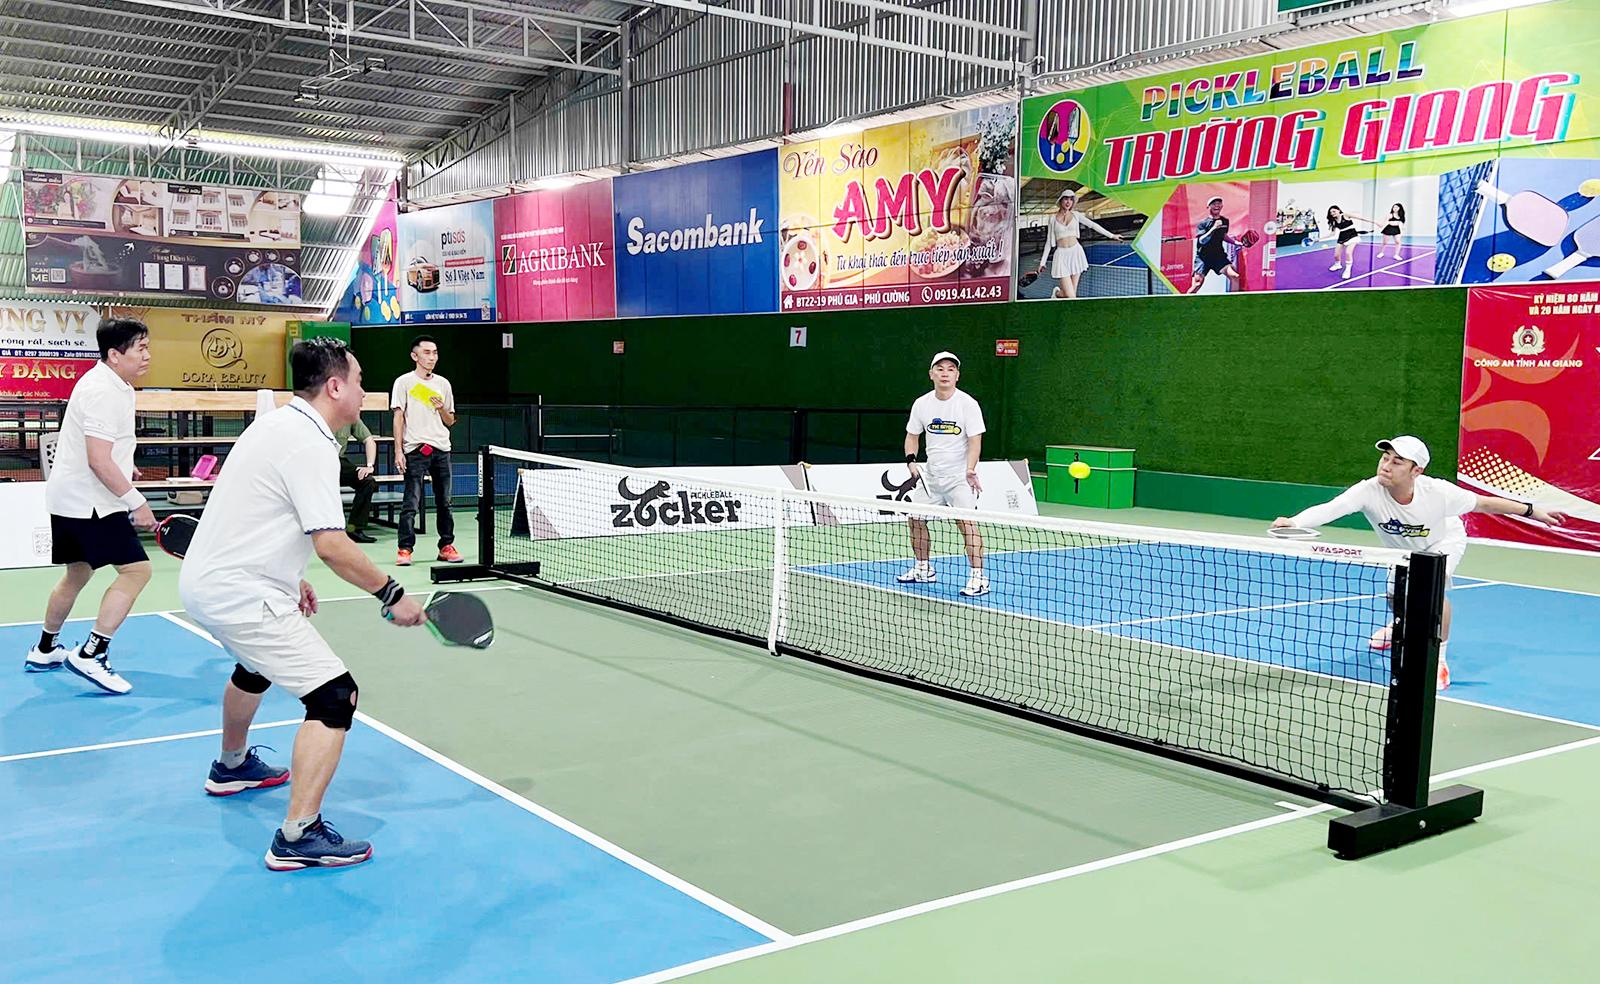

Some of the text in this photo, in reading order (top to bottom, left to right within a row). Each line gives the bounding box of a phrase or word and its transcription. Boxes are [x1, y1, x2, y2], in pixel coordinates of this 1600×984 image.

[1140, 40, 1425, 122] PICKLEBALL
[1103, 72, 1580, 187] TRƯỜNG GIANG
[783, 144, 878, 178] Yến Sào
[832, 166, 966, 244] AMY
[626, 207, 764, 256] Sacombank
[518, 242, 606, 274] AGRIBANK
[890, 247, 908, 266] đến
[31, 275, 49, 283] ME
[796, 296, 827, 308] BT22-19
[828, 292, 843, 306] PHÚ
[845, 294, 858, 305] GIA
[864, 291, 880, 304] PHÚ
[934, 286, 1002, 301] 0919.41.42.43
[1567, 293, 1579, 303] 80
[1541, 305, 1552, 315] 20
[54, 308, 90, 334] VY
[795, 330, 802, 344] 7
[12, 359, 77, 382] ĐẶNG
[1474, 358, 1500, 367] CÔNG
[1501, 359, 1514, 367] AN
[1537, 359, 1551, 367] AN
[1552, 359, 1583, 368] GIANG
[182, 372, 267, 384] DORA BEAUTY
[690, 491, 733, 499] PICKLEBALL
[610, 490, 742, 527] zocker
[1311, 546, 1363, 556] VIFASPORT
